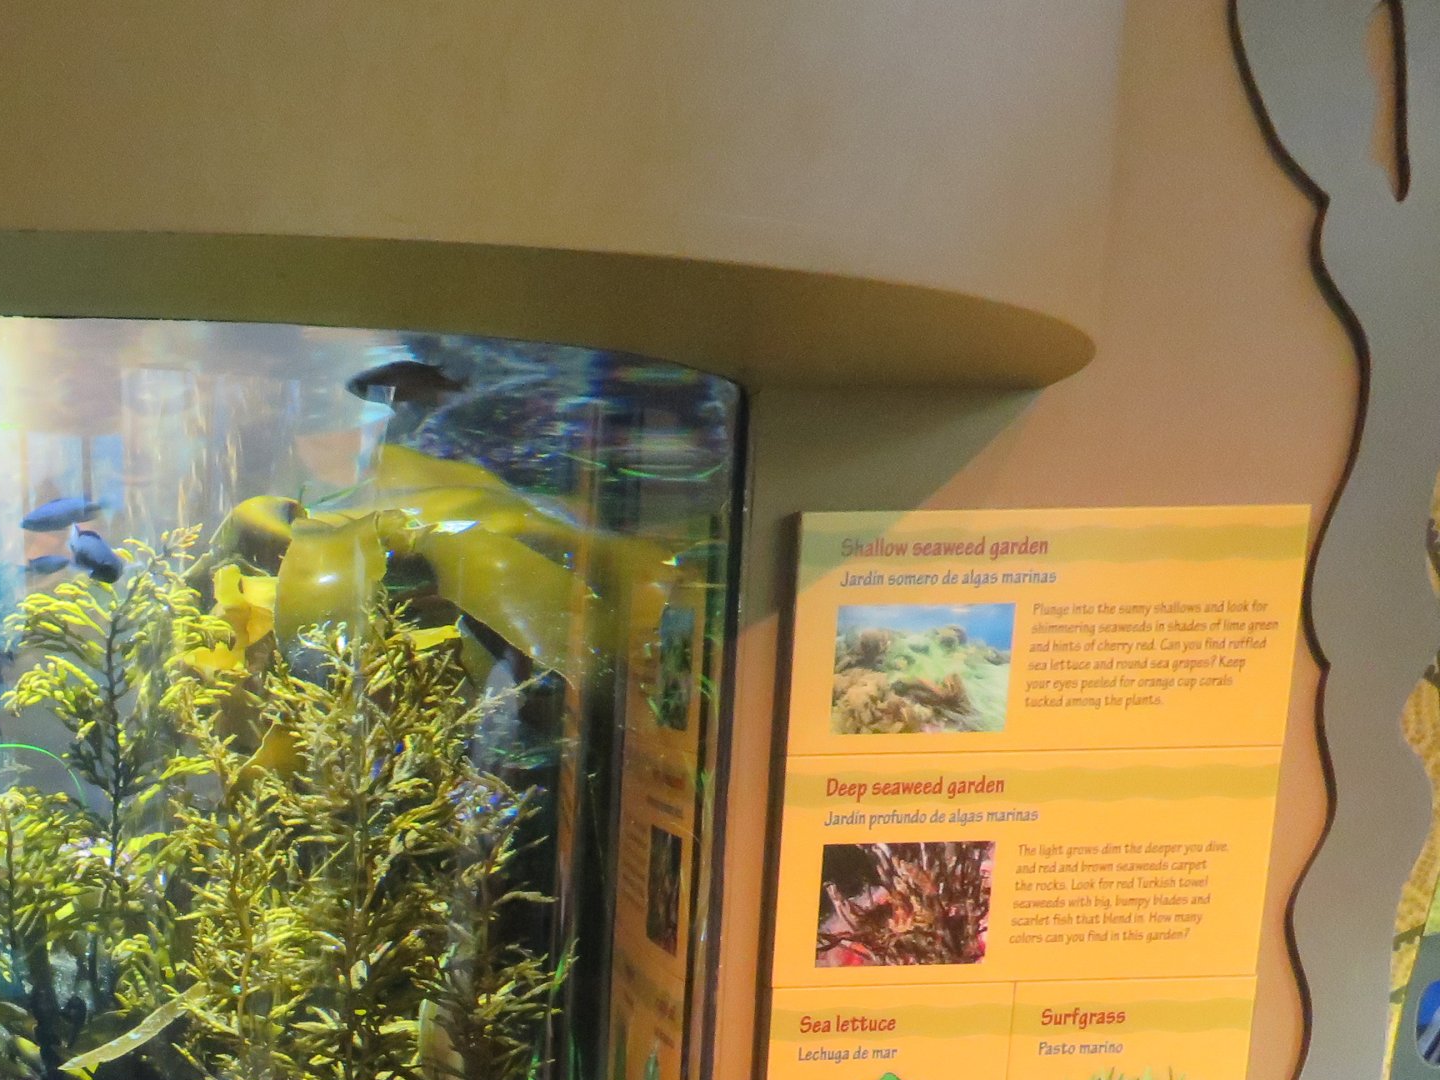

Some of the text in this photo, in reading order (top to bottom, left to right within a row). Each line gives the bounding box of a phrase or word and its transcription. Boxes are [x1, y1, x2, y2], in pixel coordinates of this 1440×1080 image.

[842, 536, 1048, 560] Shallow seaweed garden
[888, 572, 939, 585] somero
[942, 570, 958, 584] de
[962, 570, 997, 588] algas
[1002, 570, 1056, 583] marinas
[1033, 601, 1268, 617] Plunge into the sunny shallows and look for
[1032, 620, 1278, 636] shimmering seaweeds in shades of lime green
[1029, 641, 1050, 653] and
[1053, 640, 1081, 652] hints
[1084, 639, 1096, 651] of
[1097, 639, 1133, 654] cherry
[1160, 639, 1181, 650] Can
[1182, 640, 1202, 653] you
[1204, 637, 1225, 649] find
[1228, 637, 1267, 649] ruffled
[1028, 655, 1246, 672] sea lettuce and round sea grapes? Keep
[1026, 674, 1233, 693] your eyes peeled for orange cup corals
[1025, 695, 1063, 708] tucked
[1065, 696, 1100, 710] among
[1104, 694, 1122, 706] the
[826, 775, 1004, 803] Deep seaweed garden
[824, 808, 1039, 830] Jardín profundo de algas marinas
[1019, 844, 1036, 856] The
[1039, 845, 1063, 858] light
[1066, 847, 1099, 858] grows
[1101, 844, 1121, 855] dim
[1125, 843, 1142, 854] the
[1145, 843, 1181, 857] deeper
[1183, 843, 1203, 855] you
[1016, 860, 1207, 874] and red and brown seaweeds carpet
[1015, 881, 1033, 891] the
[1071, 879, 1094, 890] Look
[1099, 879, 1113, 890] for
[1116, 878, 1134, 889] red
[1137, 877, 1175, 889] Turkish
[1179, 876, 1208, 888] towel
[1013, 897, 1065, 909] seaweeds
[1068, 897, 1091, 908] with
[1115, 895, 1150, 910] bumpy
[1153, 894, 1188, 906] blades
[1191, 893, 1210, 905] and
[1011, 915, 1049, 927] scarlet
[1053, 915, 1073, 925] fish
[1076, 914, 1100, 925] that
[1103, 912, 1131, 924] blend
[1149, 913, 1171, 923] How
[1174, 913, 1202, 925] many
[1009, 928, 1190, 945] colors can you find in this garden?
[800, 1015, 896, 1033] Sea lettuce
[1041, 1008, 1125, 1029] Surfgrass
[798, 1046, 897, 1063] Lechuga de mar
[1039, 1041, 1123, 1055] Pasto marino
